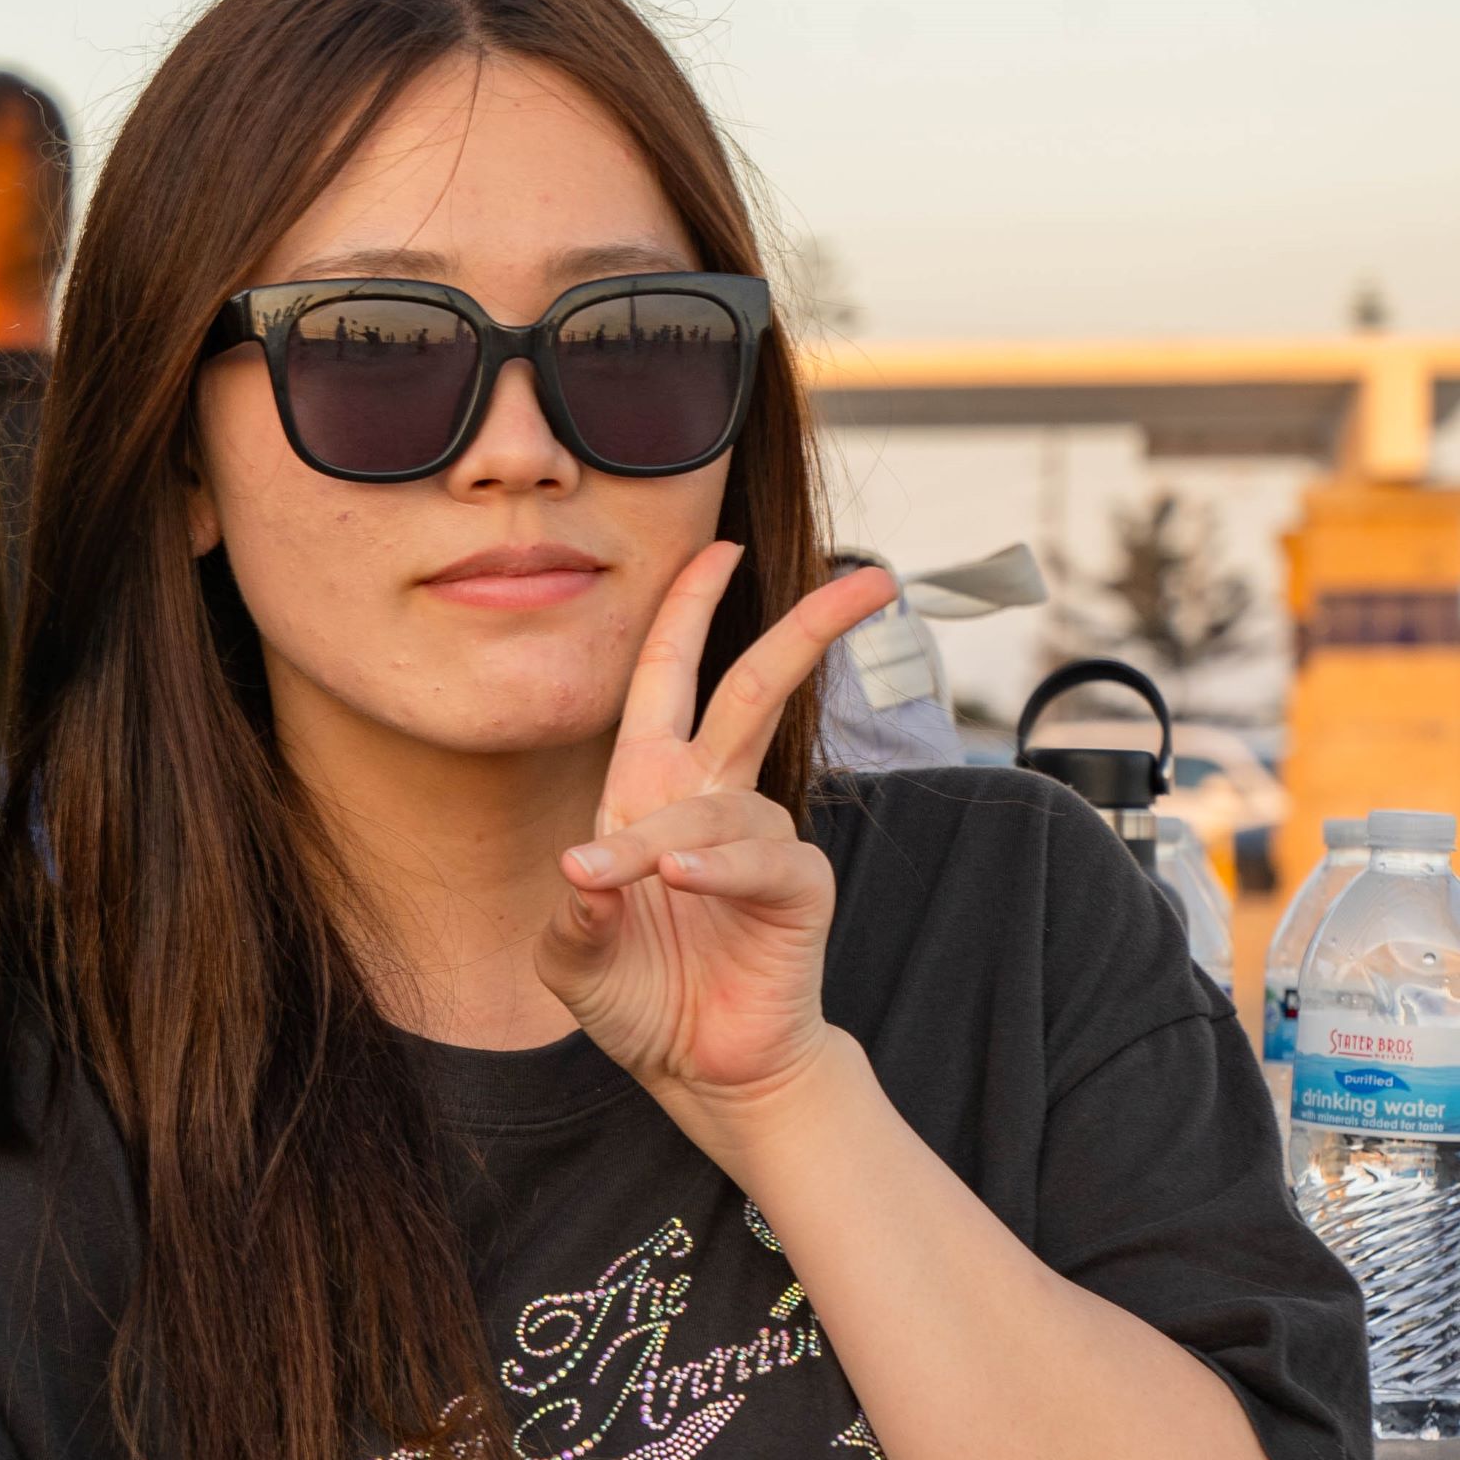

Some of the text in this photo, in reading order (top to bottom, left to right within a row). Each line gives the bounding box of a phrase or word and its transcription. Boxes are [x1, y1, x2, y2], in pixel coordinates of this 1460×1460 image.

[1330, 1028, 1373, 1055] STATER
[1344, 1074, 1394, 1088] purified
[1302, 1089, 1446, 1119] drinking water
[1317, 1113, 1359, 1127] minerals
[1362, 1117, 1398, 1130] added
[1400, 1120, 1415, 1131] for
[1419, 1121, 1445, 1133] taste
[500, 1217, 695, 1397] The
